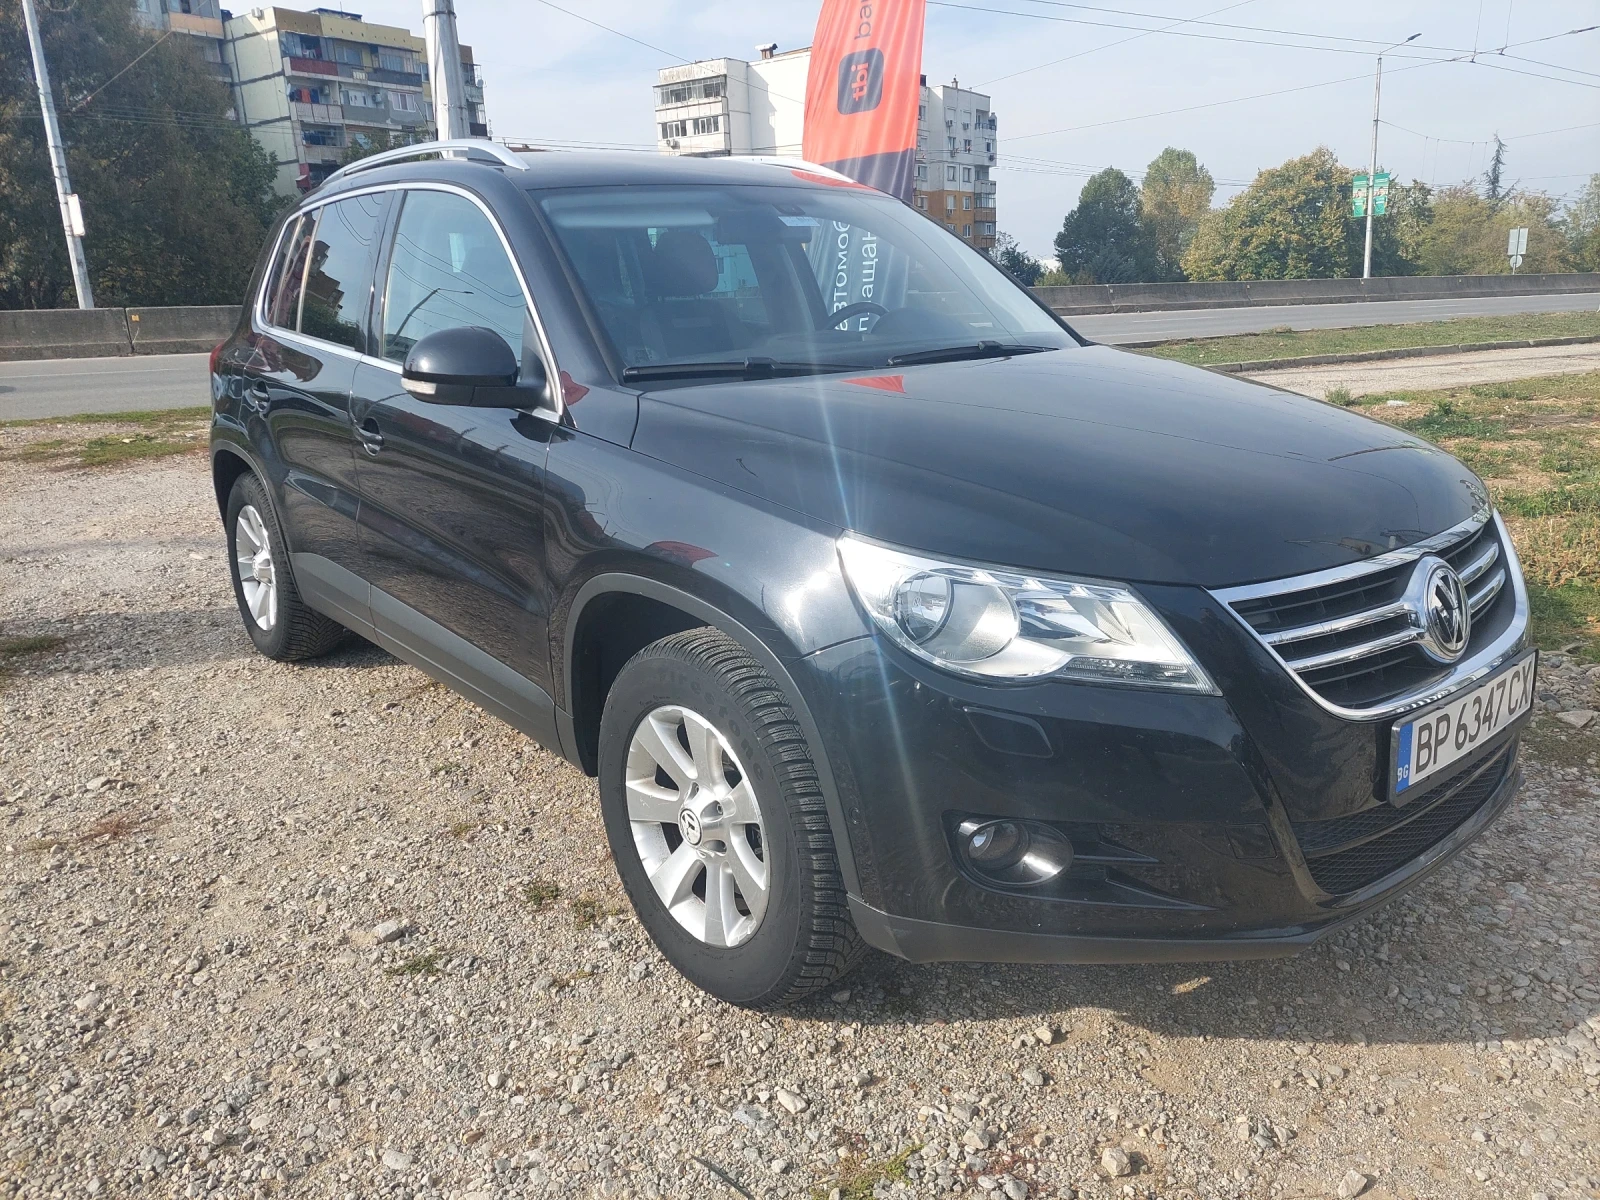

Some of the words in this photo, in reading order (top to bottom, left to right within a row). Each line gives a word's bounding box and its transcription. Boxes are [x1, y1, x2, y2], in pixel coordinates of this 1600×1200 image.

[854, 0, 872, 40] ba
[851, 62, 869, 101] tbi
[1415, 713, 1450, 775] BP
[1454, 678, 1506, 751] 6347
[1507, 660, 1532, 716] CX
[1397, 764, 1409, 781] BG
